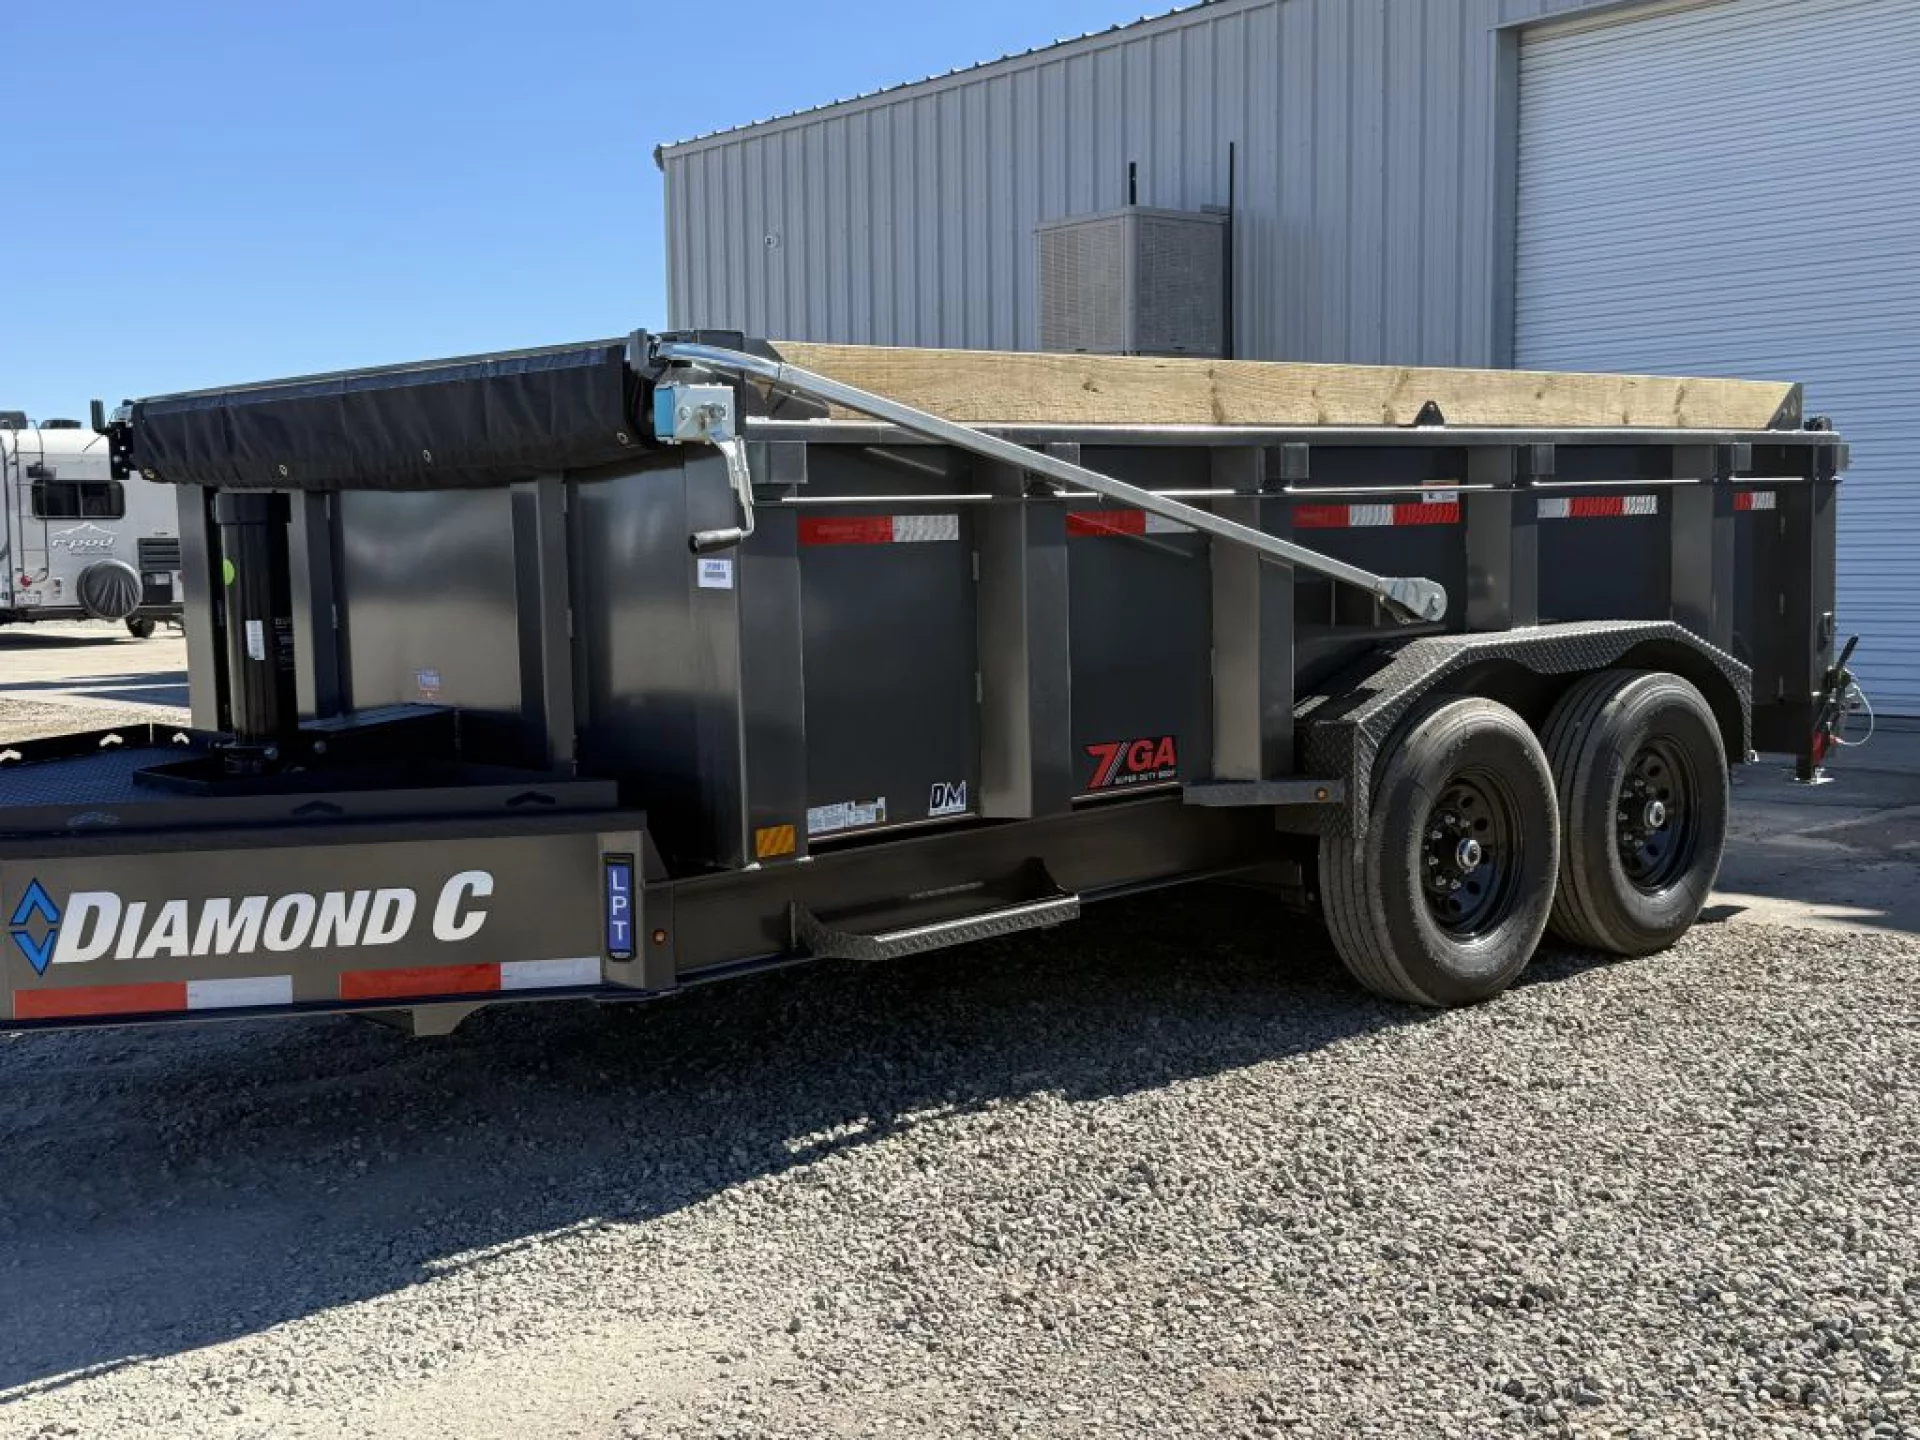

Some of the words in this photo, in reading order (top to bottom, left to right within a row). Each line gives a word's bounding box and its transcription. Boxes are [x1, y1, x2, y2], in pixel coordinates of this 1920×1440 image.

[930, 781, 966, 810] DM
[52, 888, 416, 964] DIAMOND
[433, 870, 494, 942] C
